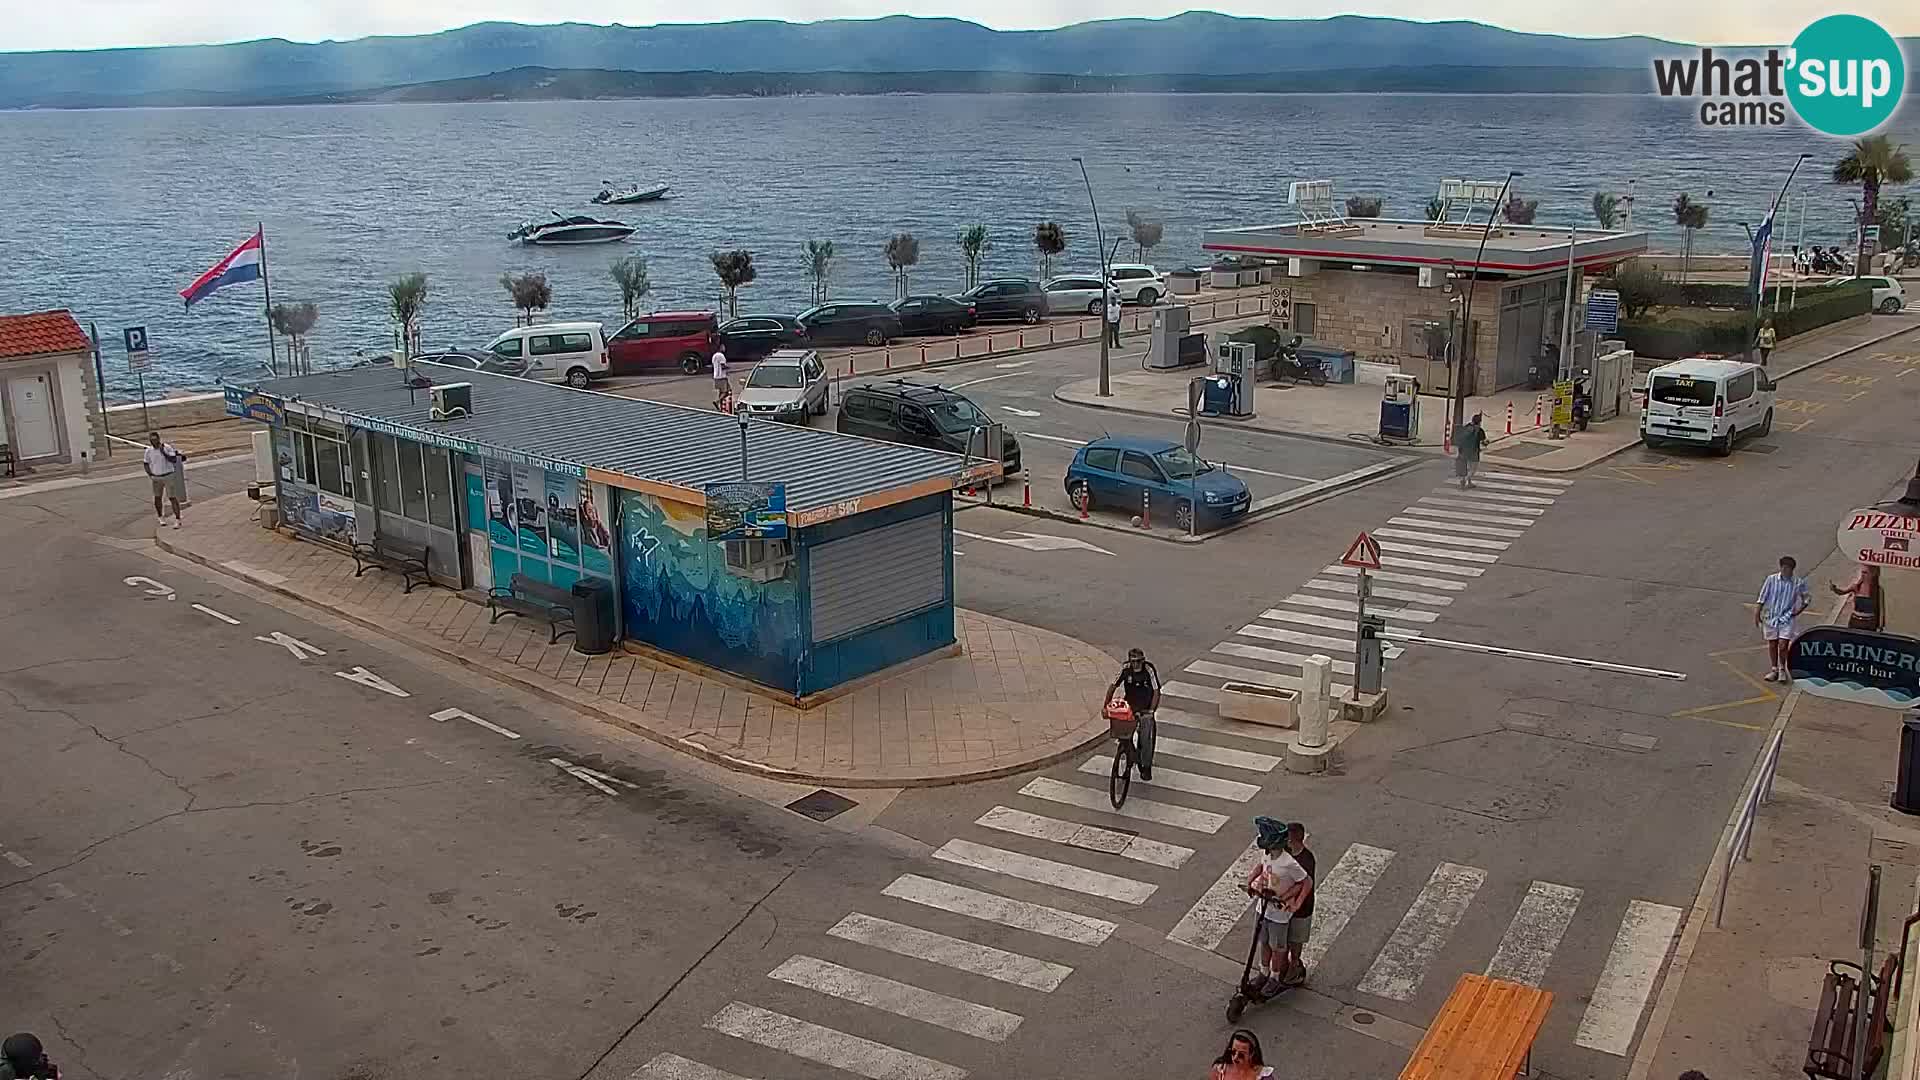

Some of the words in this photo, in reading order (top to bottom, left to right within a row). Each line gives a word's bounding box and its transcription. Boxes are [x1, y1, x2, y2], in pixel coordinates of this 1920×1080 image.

[130, 330, 142, 349] P
[1674, 379, 1695, 388] TAXI
[435, 435, 467, 450] POSTAJA
[477, 445, 493, 456] BUS
[492, 447, 526, 465] STATION
[527, 456, 553, 470] TICKET
[555, 460, 582, 476] OFFICE
[1881, 530, 1916, 540] GRILL
[1859, 548, 1920, 568] Skalinad
[1869, 664, 1896, 679] bar
